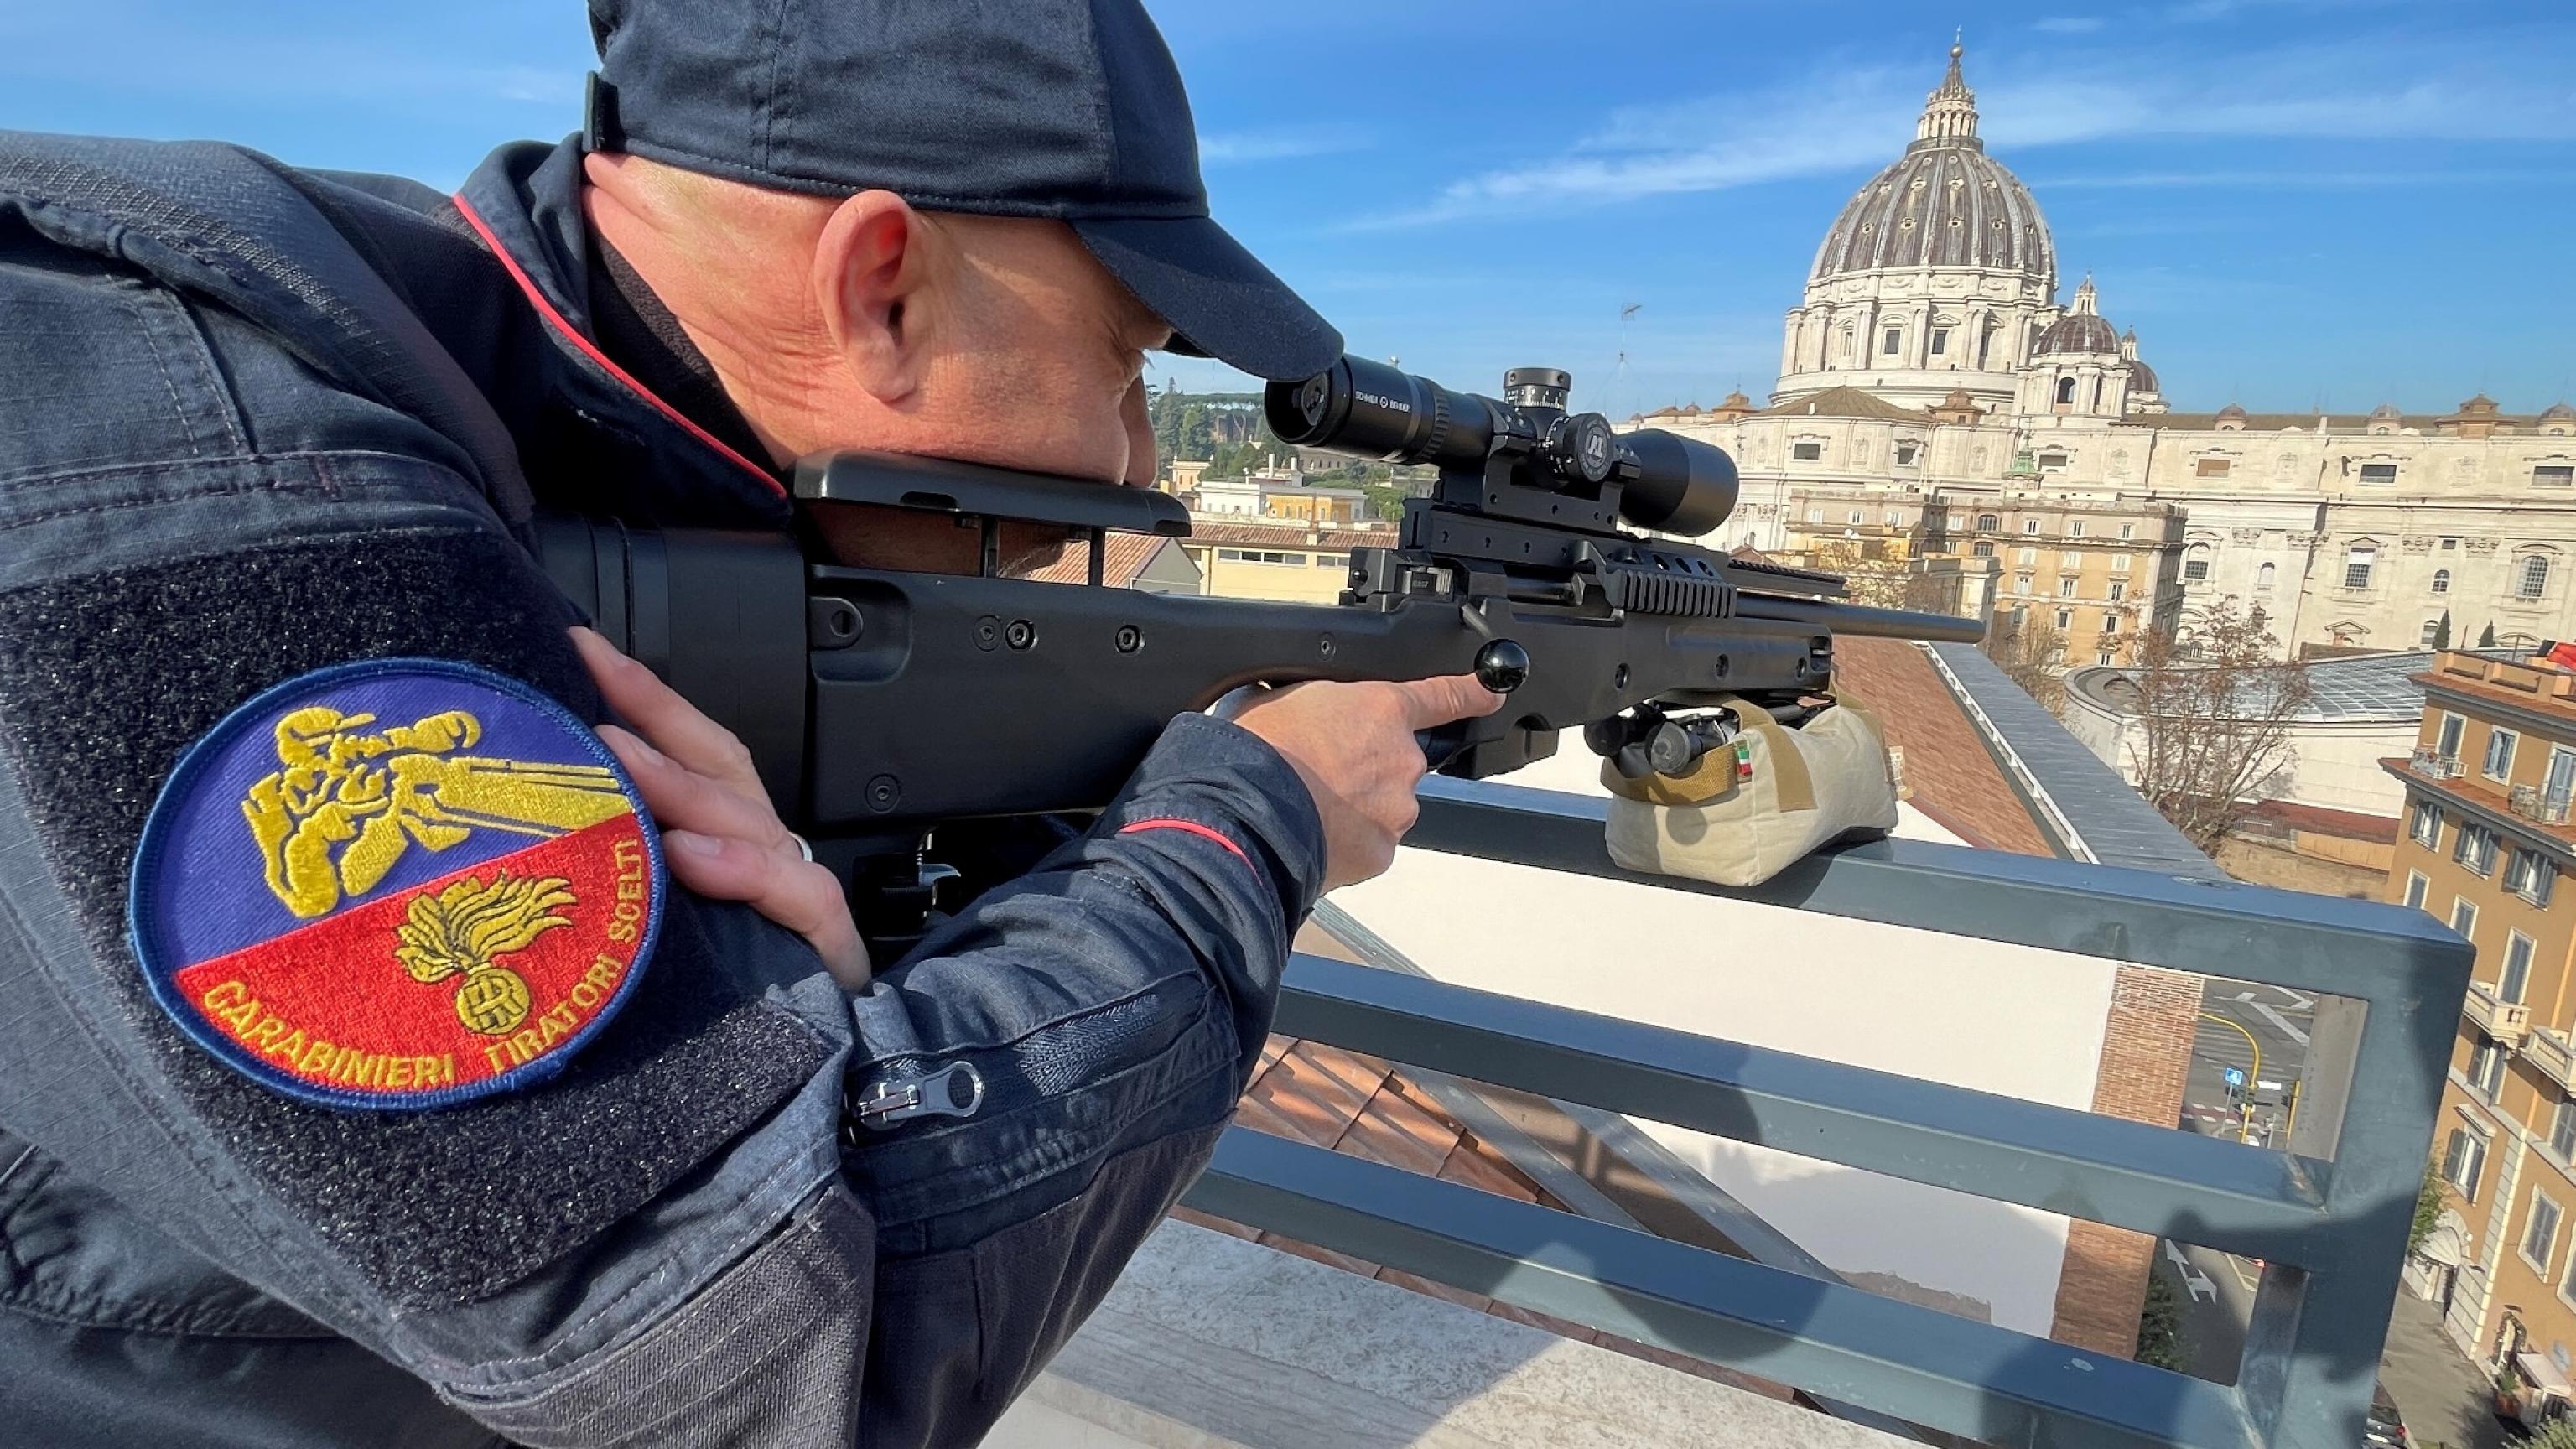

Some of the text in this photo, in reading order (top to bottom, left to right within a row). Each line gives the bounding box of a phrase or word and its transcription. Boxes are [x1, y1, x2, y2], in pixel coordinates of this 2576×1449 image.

[204, 980, 454, 1088] CARABINIERI
[484, 953, 622, 1074] TIRATORI
[608, 839, 643, 943] SCELTI
